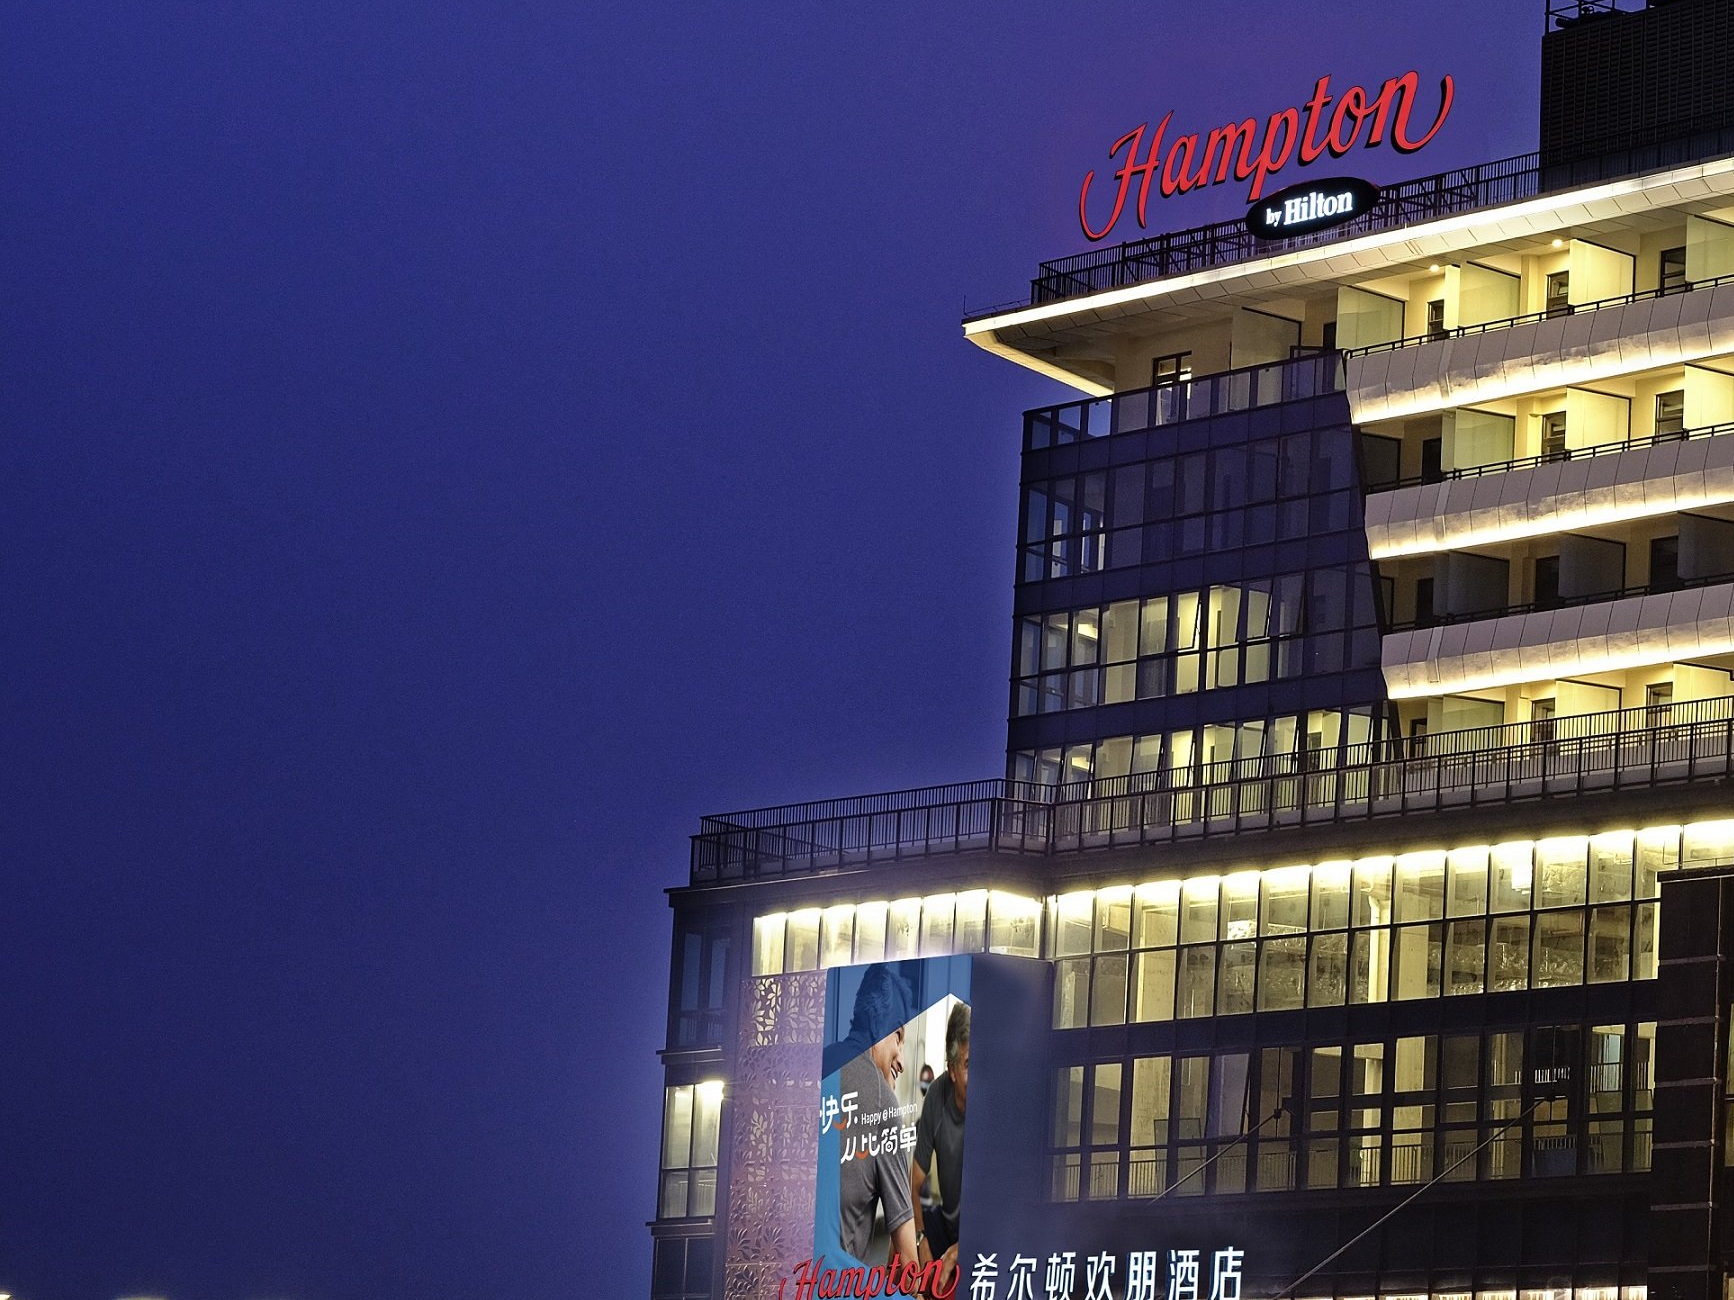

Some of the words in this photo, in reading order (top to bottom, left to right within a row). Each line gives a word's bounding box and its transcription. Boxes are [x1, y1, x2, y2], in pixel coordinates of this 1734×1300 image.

[1080, 70, 1455, 242] Hampton
[1266, 207, 1282, 228] by
[1284, 189, 1353, 227] Hilton
[820, 1091, 859, 1134] 快乐
[861, 1111, 882, 1126] Happy
[889, 1103, 918, 1119] Hampton
